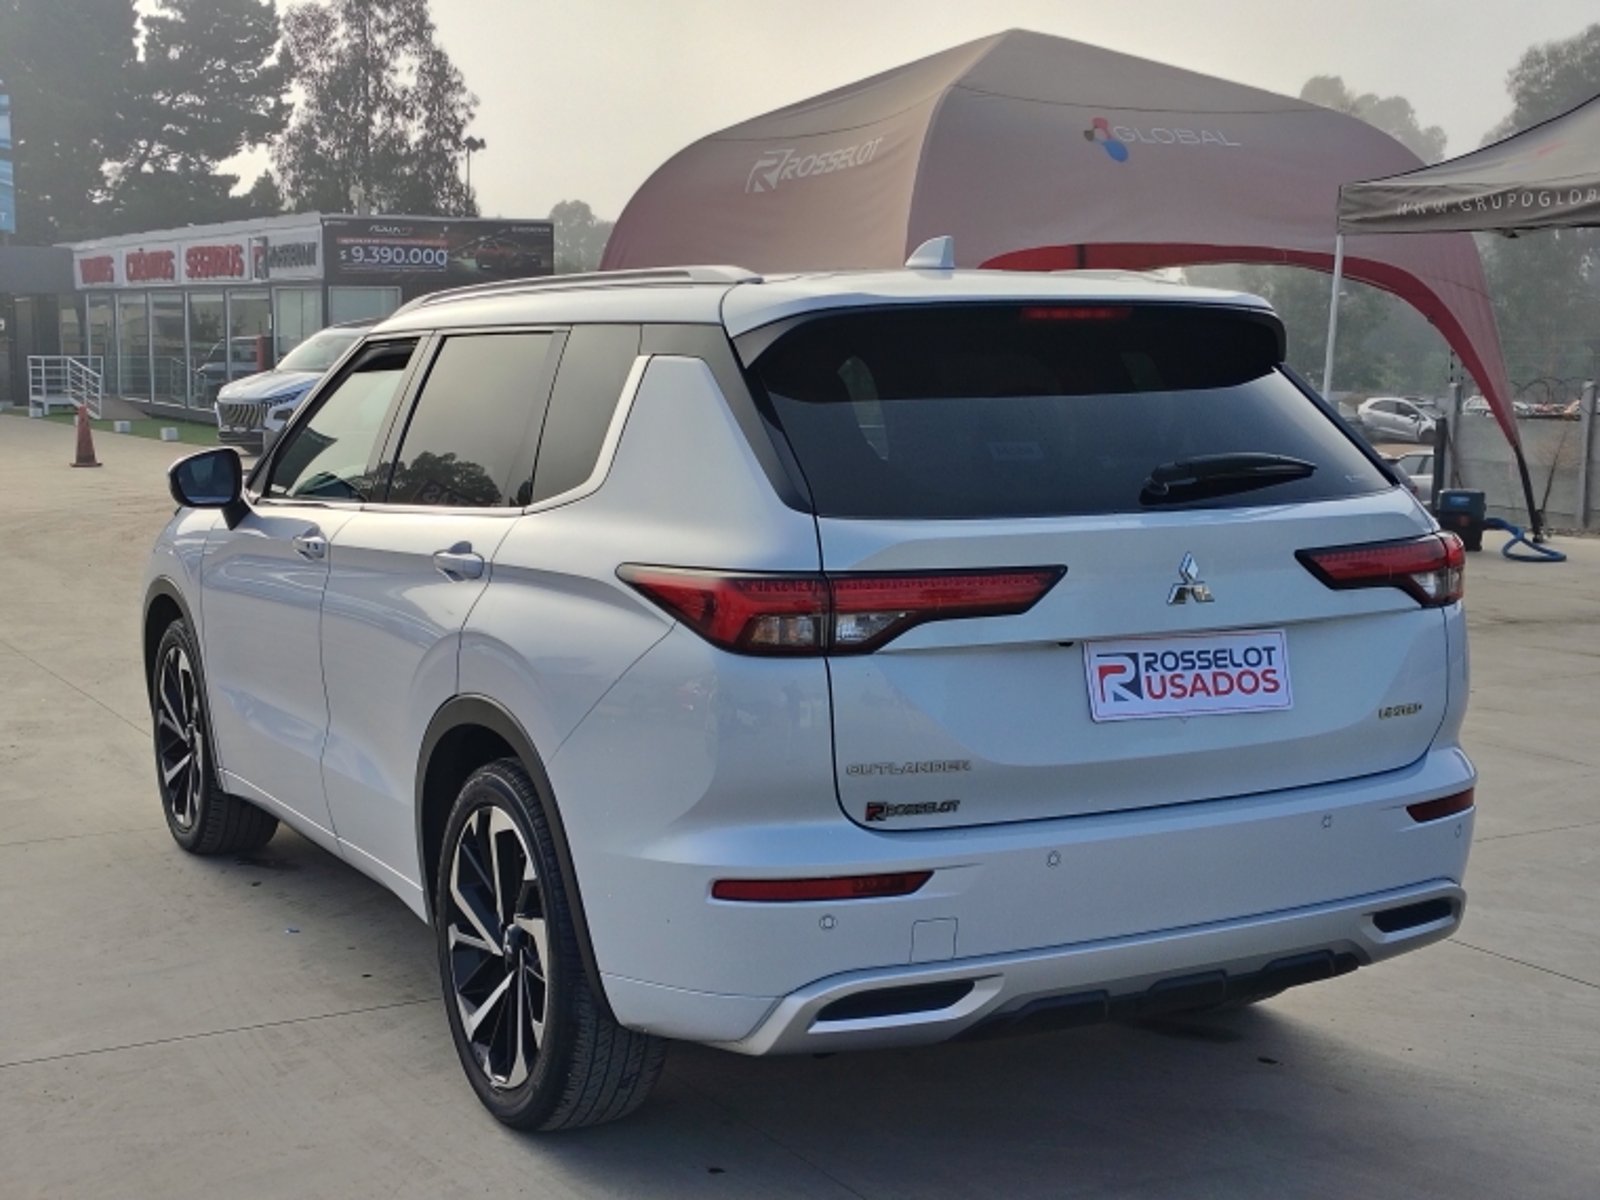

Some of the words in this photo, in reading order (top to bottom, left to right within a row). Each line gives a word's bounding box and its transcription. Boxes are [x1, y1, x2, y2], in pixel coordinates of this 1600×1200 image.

[1113, 126, 1242, 146] GLOBAL
[780, 136, 884, 181] ROSSELOT
[350, 246, 449, 266] 9.390.000
[1143, 646, 1277, 673] ROSSELOT
[1145, 668, 1281, 700] USADOS
[846, 760, 972, 776] OUTLANDER
